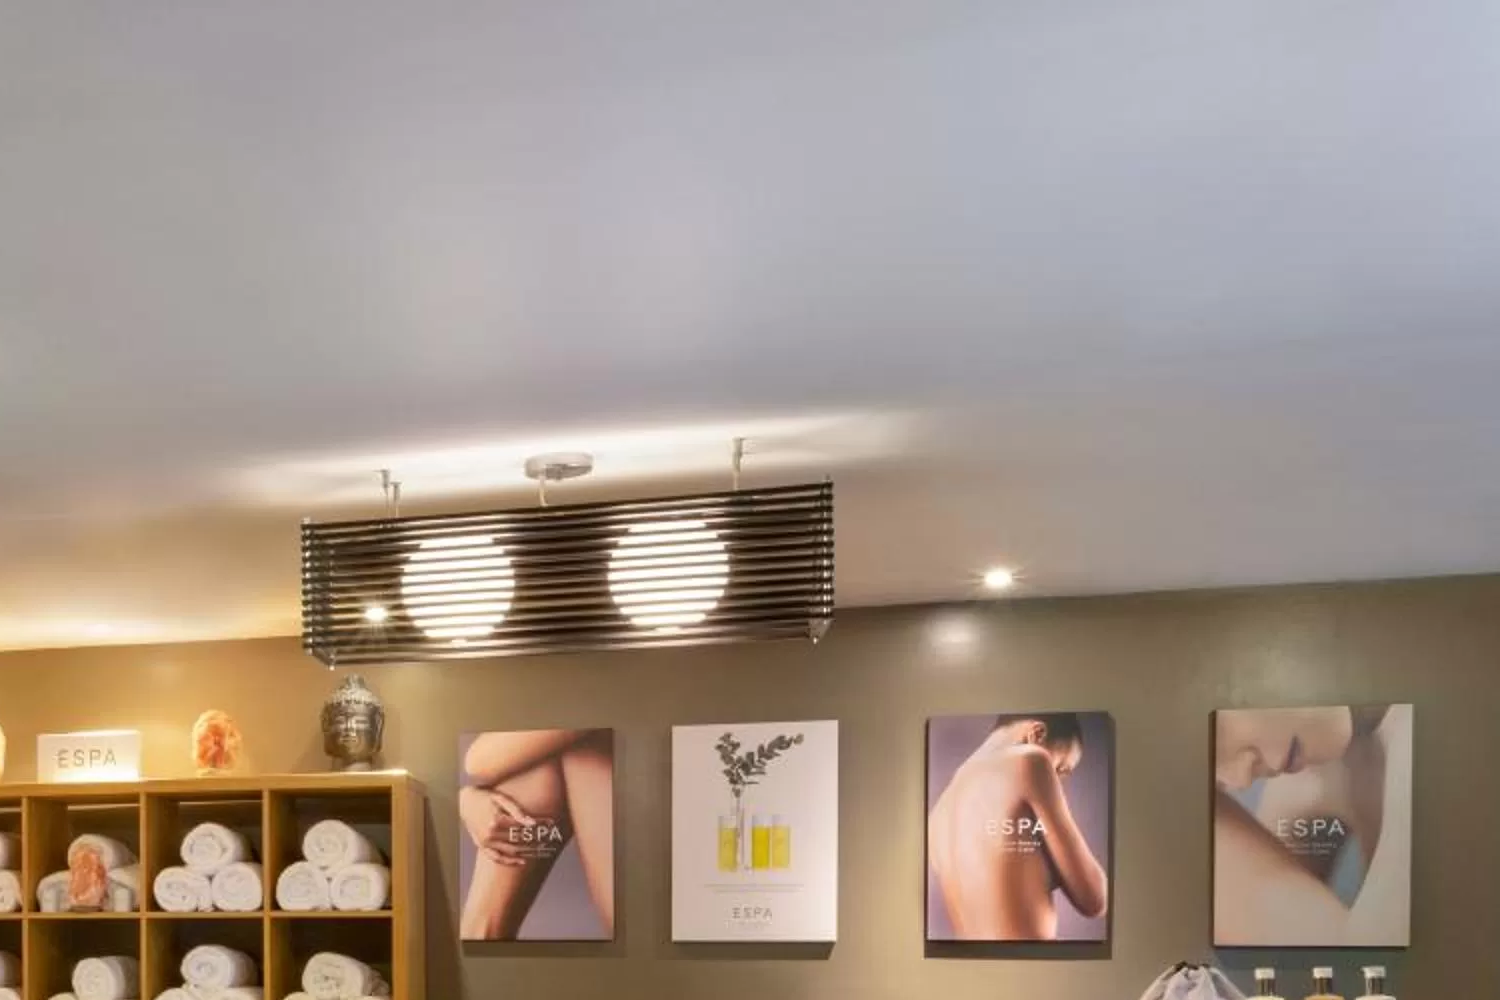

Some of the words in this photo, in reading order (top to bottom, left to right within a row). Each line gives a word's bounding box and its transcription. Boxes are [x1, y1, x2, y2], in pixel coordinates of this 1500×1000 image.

[57, 748, 117, 768] ESPA
[508, 825, 562, 843] ESPA
[987, 818, 1048, 835] ESPA
[1276, 818, 1345, 837] ESPA
